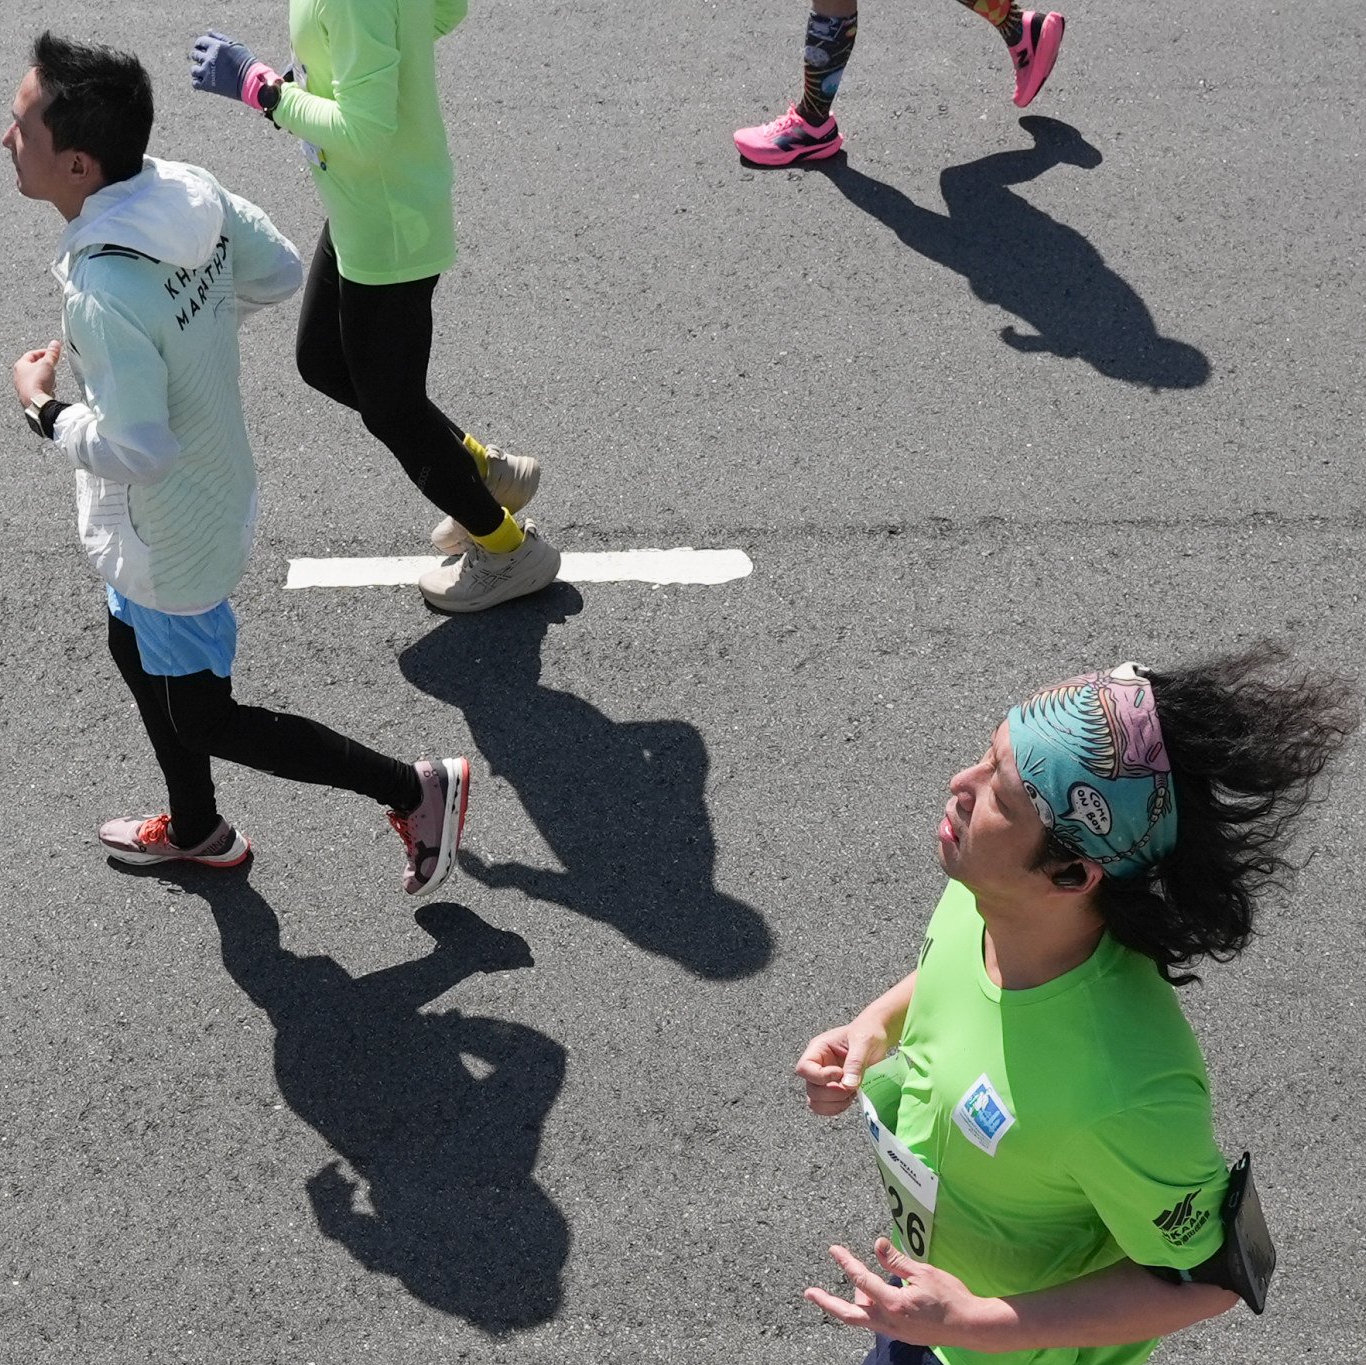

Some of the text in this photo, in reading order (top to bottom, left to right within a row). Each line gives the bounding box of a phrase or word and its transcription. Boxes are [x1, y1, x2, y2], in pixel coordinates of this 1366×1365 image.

[1077, 789, 1102, 831] ON BOY
[1090, 792, 1108, 822] COME
